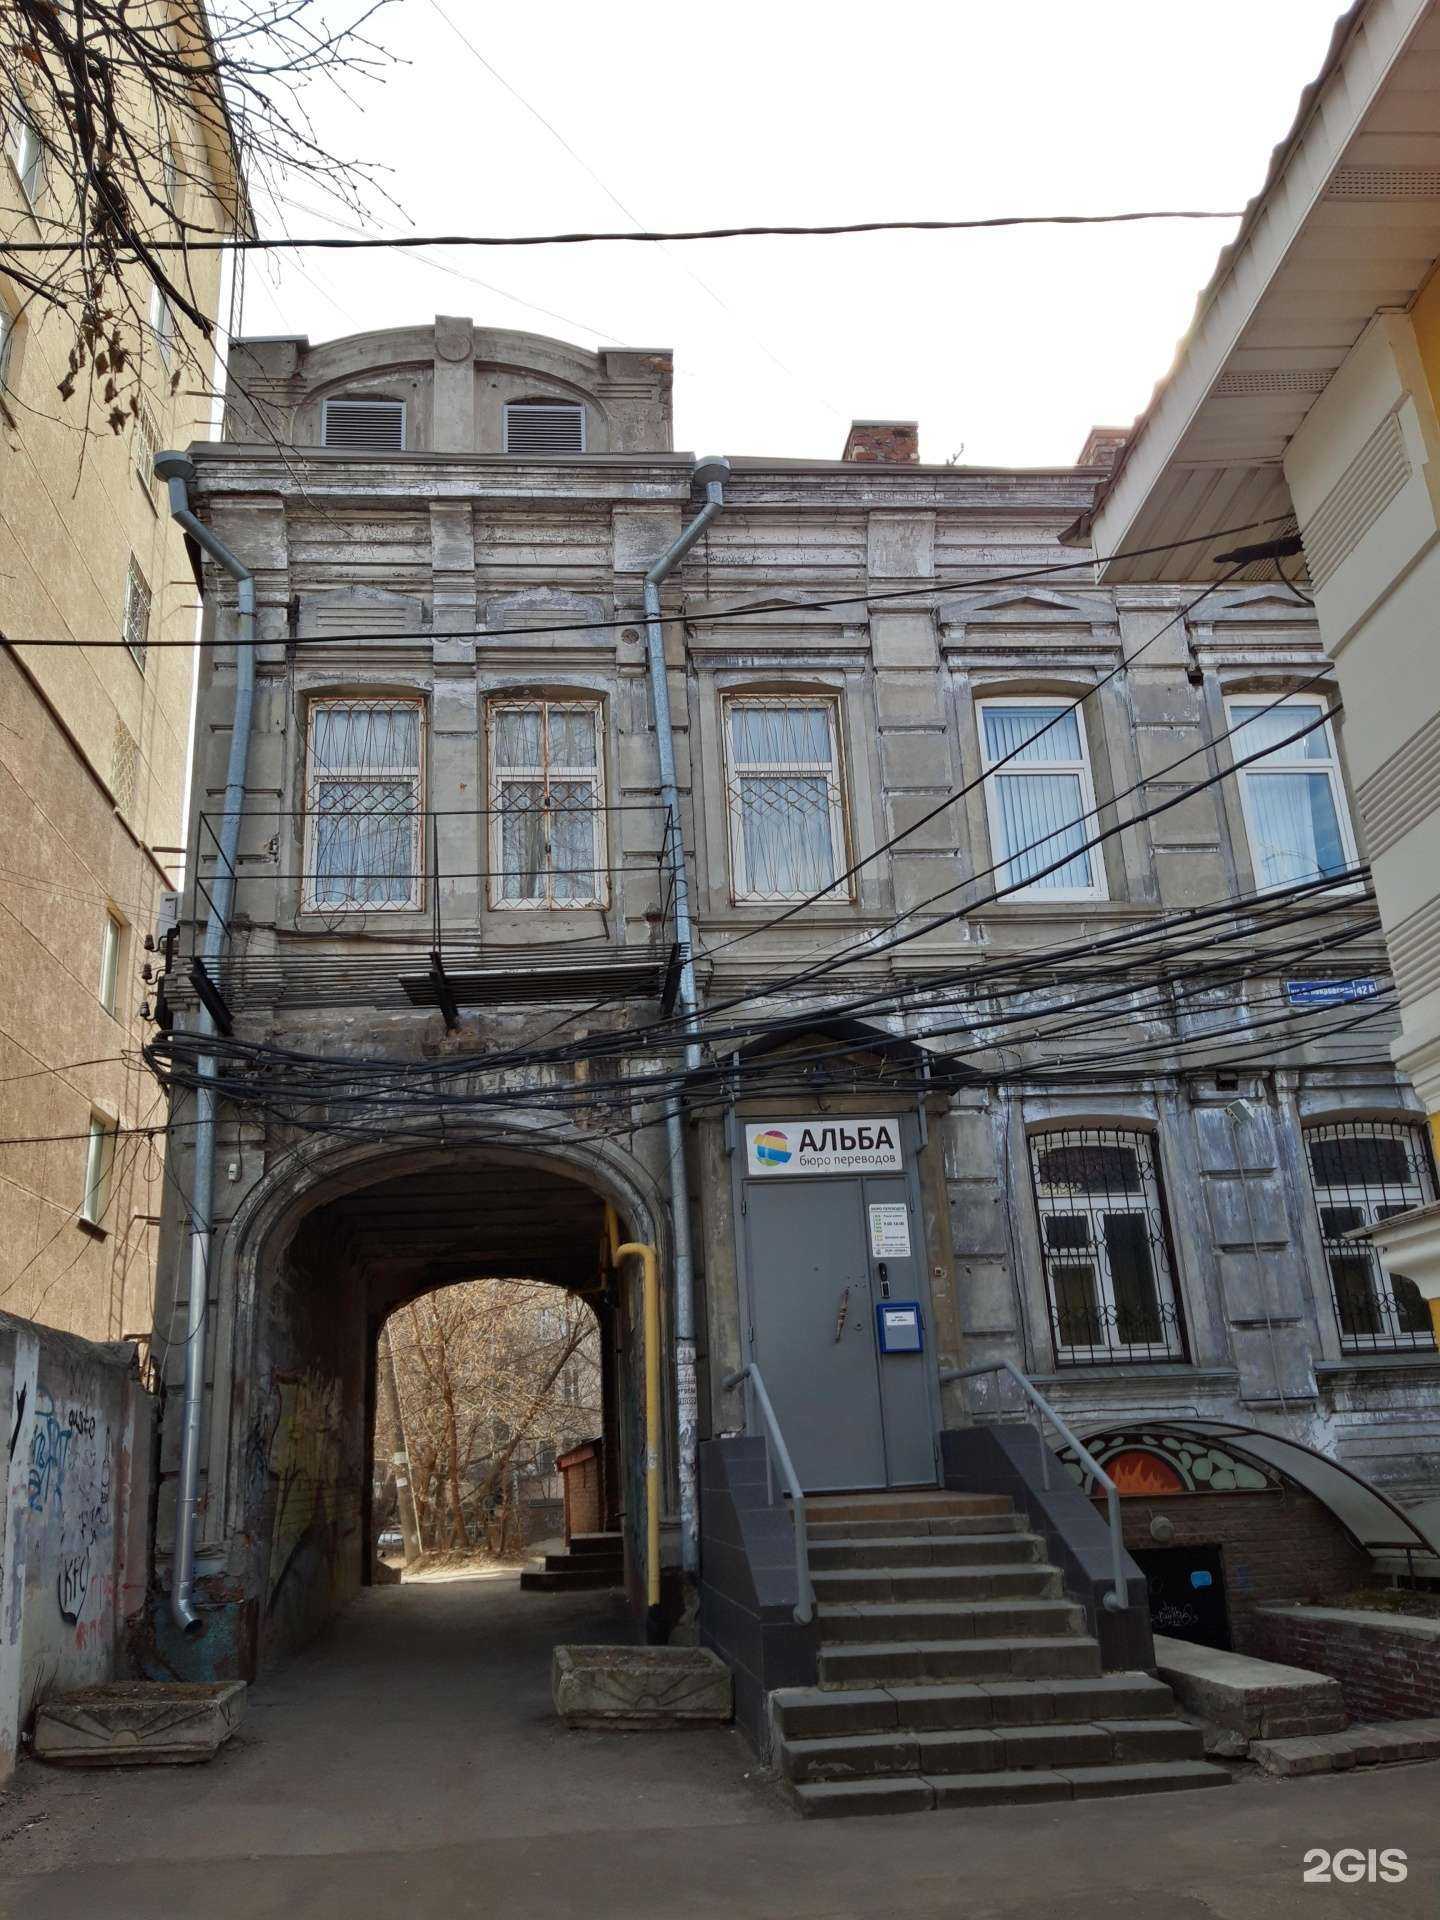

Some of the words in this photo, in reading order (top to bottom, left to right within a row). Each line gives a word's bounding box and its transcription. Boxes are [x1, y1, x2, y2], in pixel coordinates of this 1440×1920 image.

[799, 1126, 894, 1152] АЛЬБА
[800, 1155, 831, 1168] бюро
[834, 1154, 896, 1167] переводов
